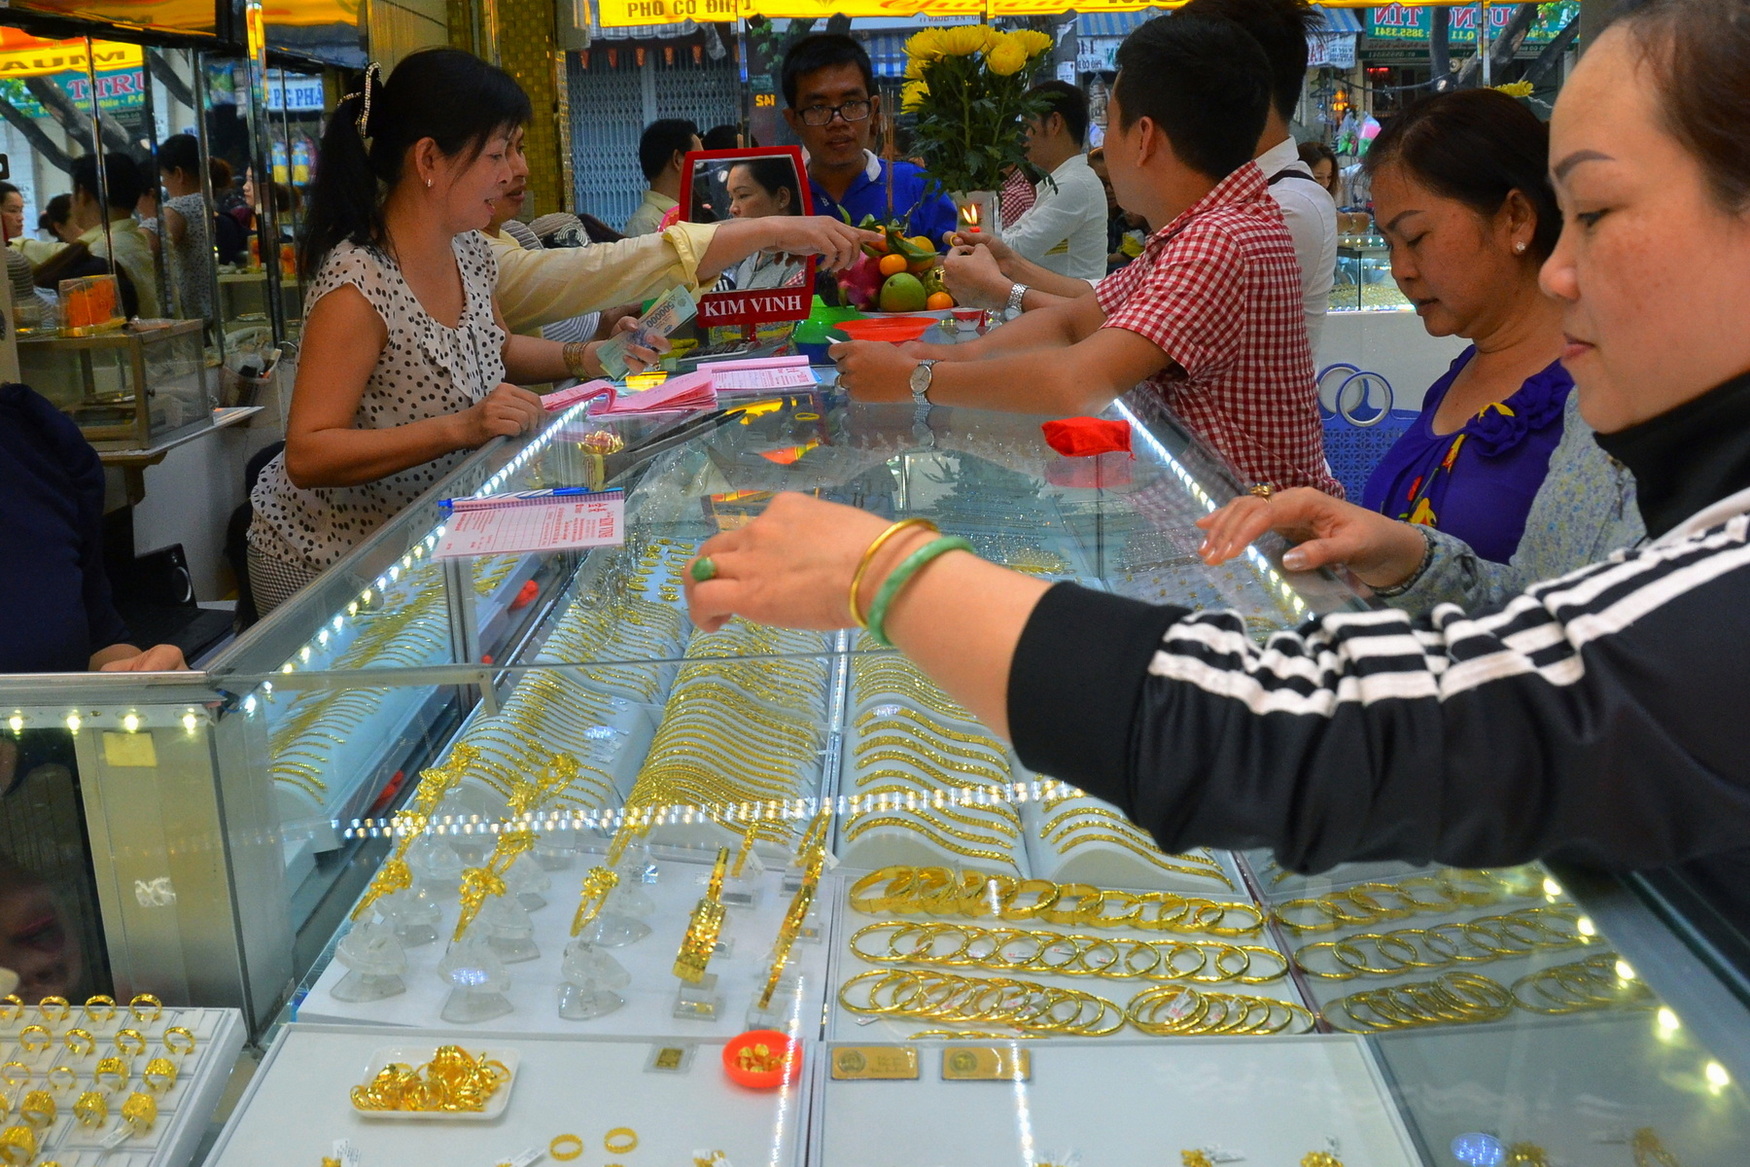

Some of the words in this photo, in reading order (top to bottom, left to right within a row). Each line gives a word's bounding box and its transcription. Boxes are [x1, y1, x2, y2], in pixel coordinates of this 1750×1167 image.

[646, 301, 676, 328] 500000
[704, 299, 746, 317] KIM
[750, 295, 802, 313] VINH
